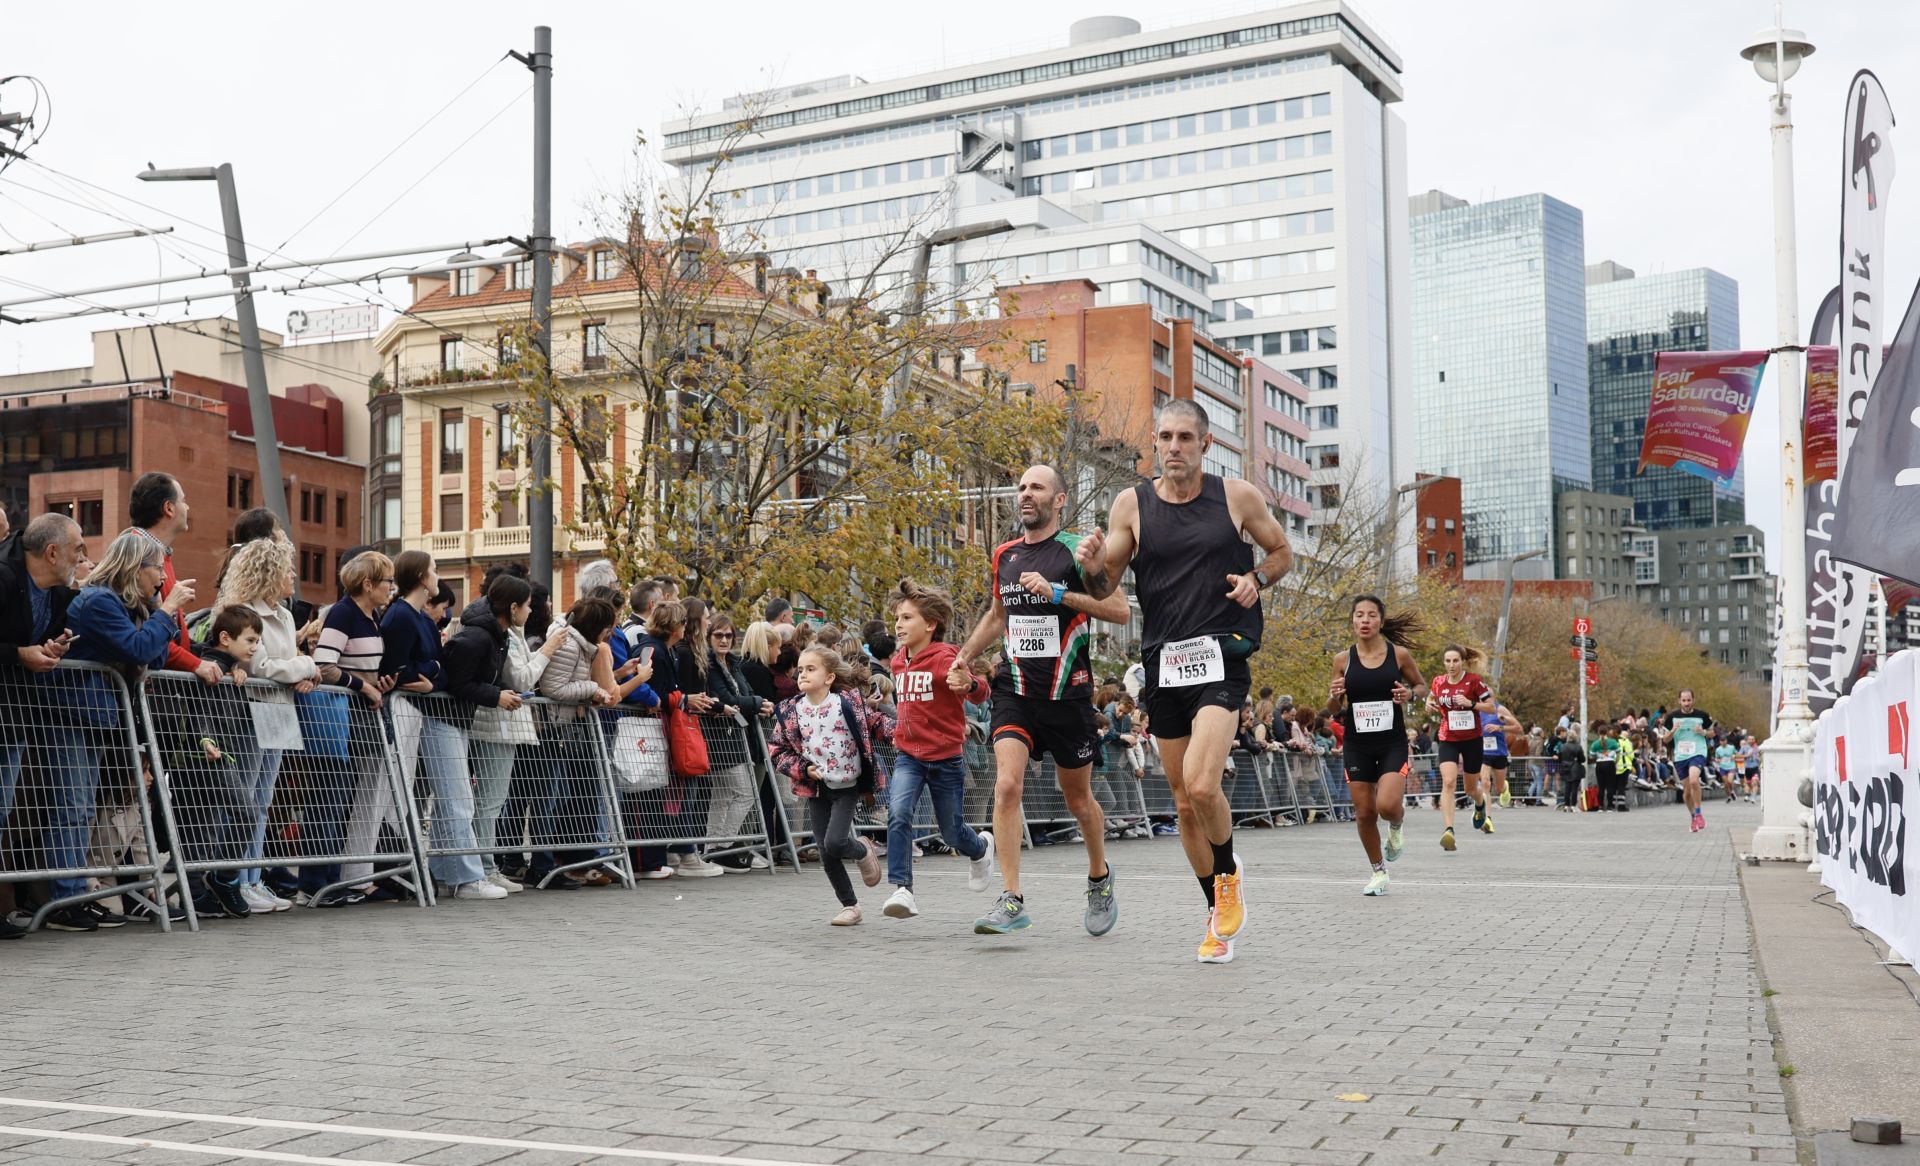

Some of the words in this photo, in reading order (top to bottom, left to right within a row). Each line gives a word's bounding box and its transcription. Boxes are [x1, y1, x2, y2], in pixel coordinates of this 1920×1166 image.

[1656, 368, 1695, 388] Fair
[1653, 384, 1751, 414] Saturday
[1020, 638, 1045, 652] 2286
[1175, 640, 1204, 651] CORREO
[1165, 653, 1188, 666] XXXVI
[1189, 653, 1216, 663] BILBAO
[1177, 662, 1207, 680] 1553
[1365, 717, 1380, 728] 717
